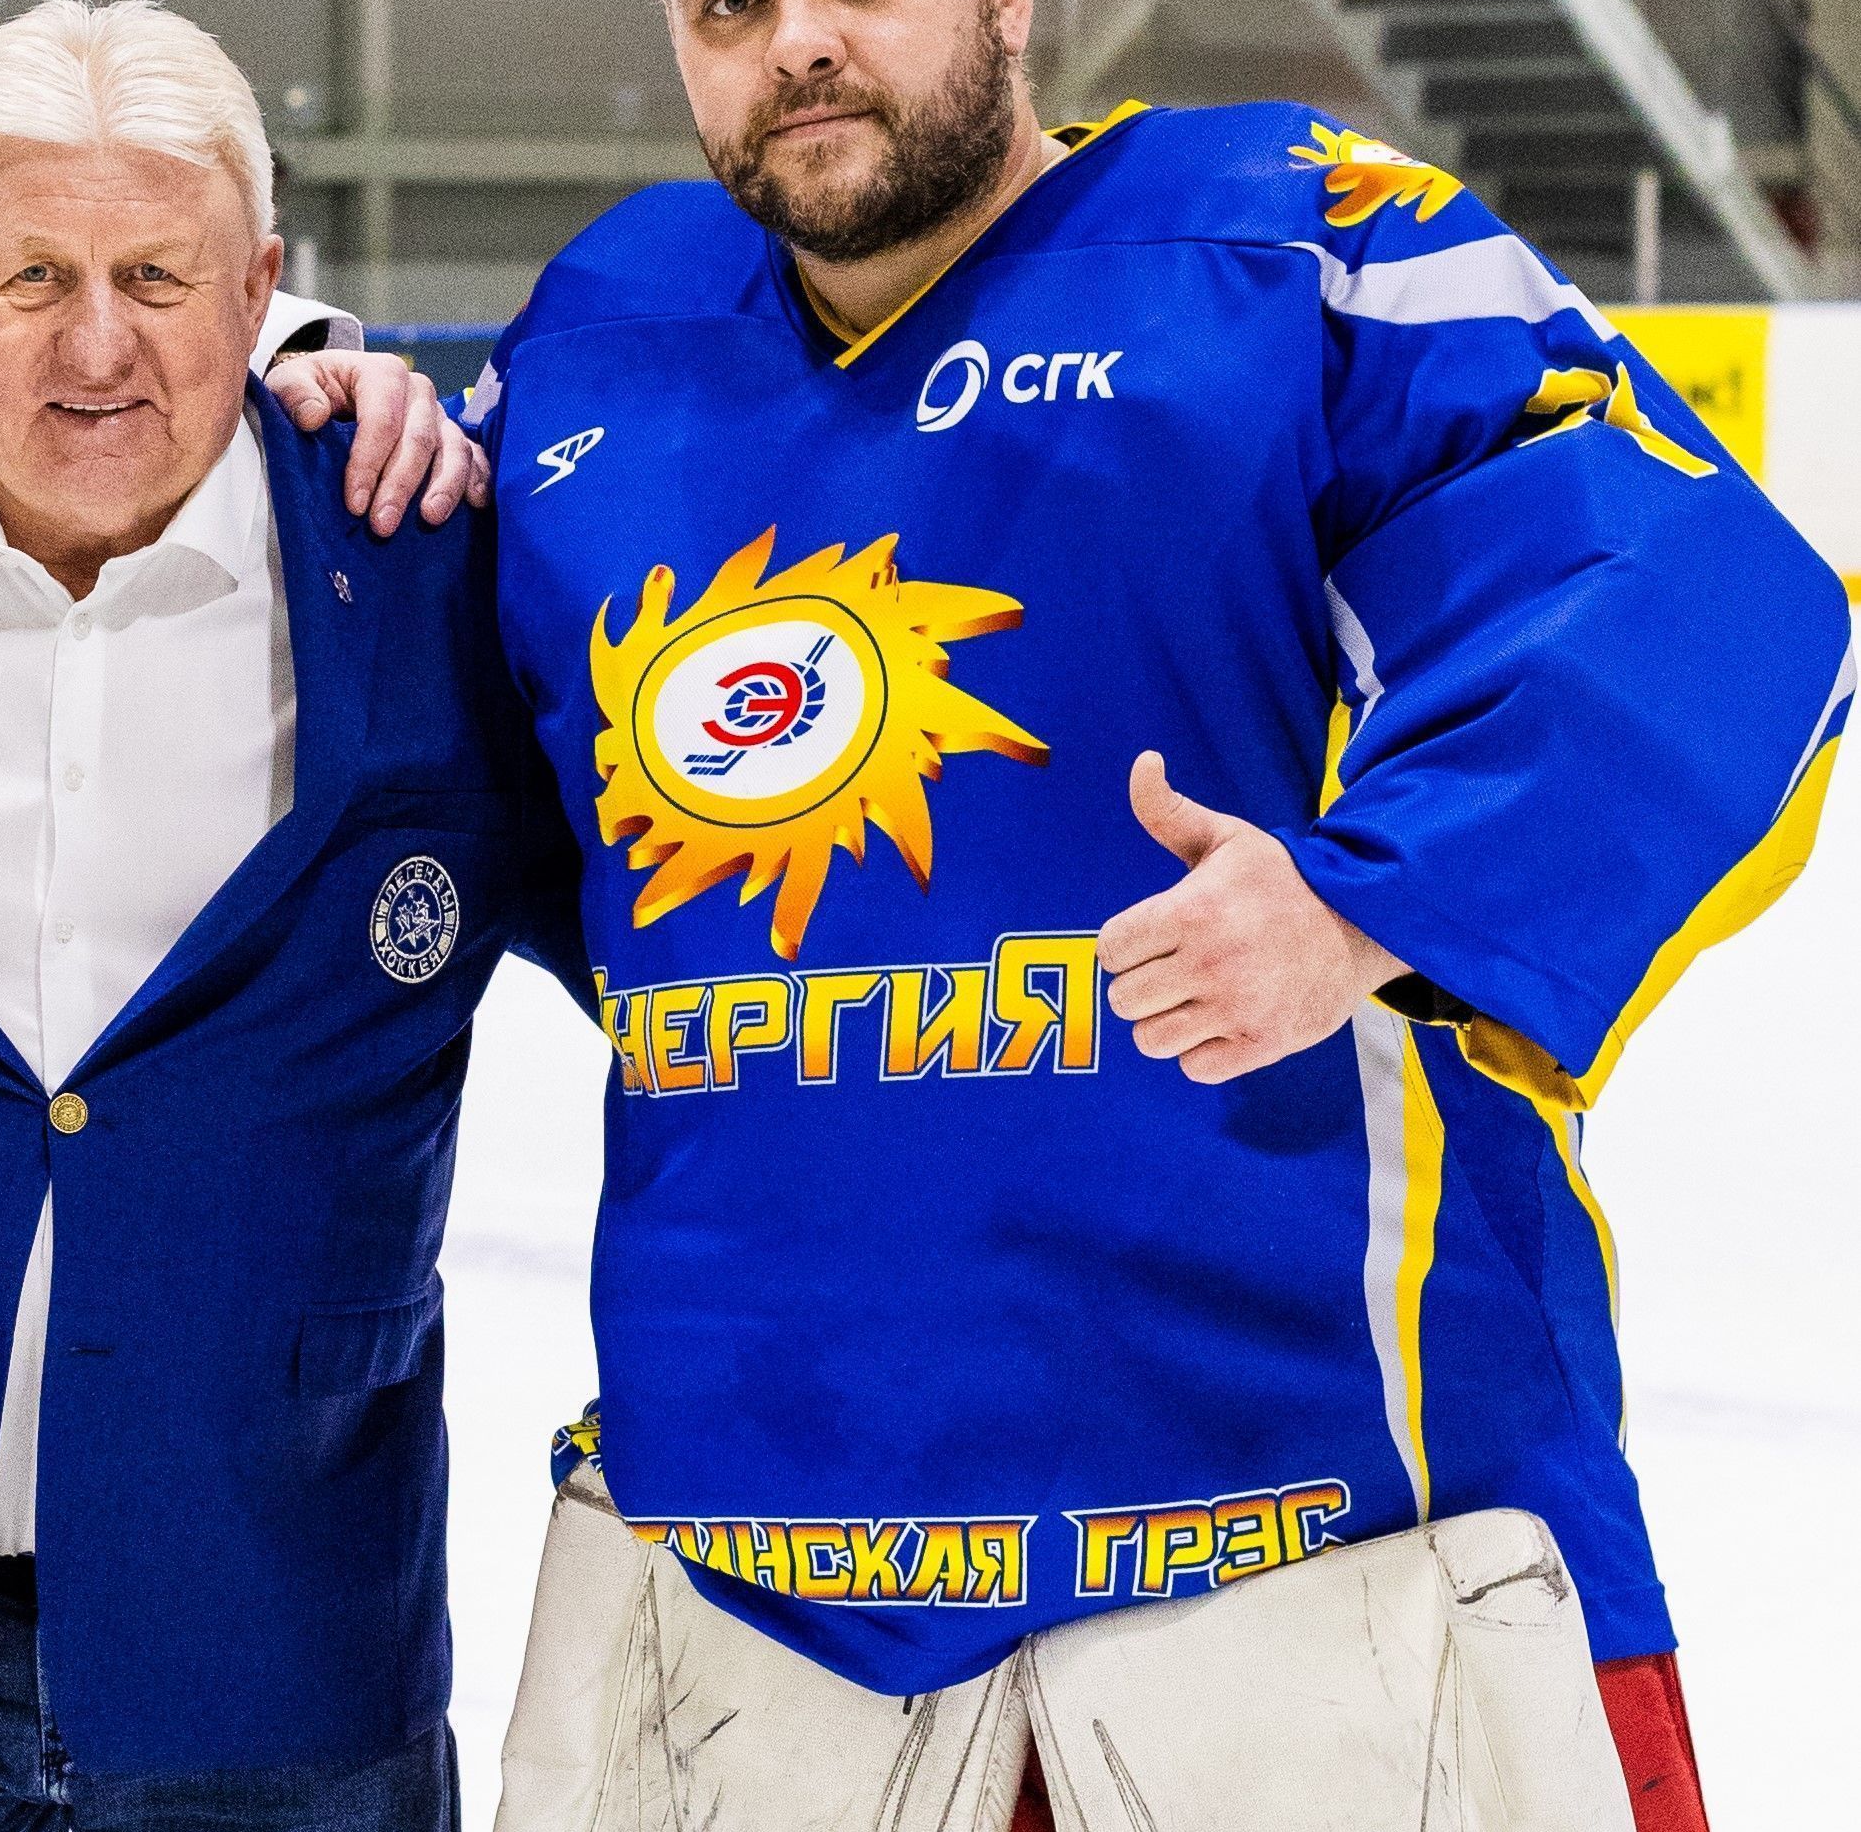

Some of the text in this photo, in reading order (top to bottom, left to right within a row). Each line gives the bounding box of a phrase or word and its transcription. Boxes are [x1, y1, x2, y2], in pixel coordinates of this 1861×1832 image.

[1001, 350, 1125, 403] СГК
[384, 862, 456, 910] ЛЕГЕНДЫ
[377, 937, 442, 979] ХОККЕЯ
[591, 931, 1102, 1099] НЕРГИЯ
[1062, 1478, 1352, 1599] ГРЭС
